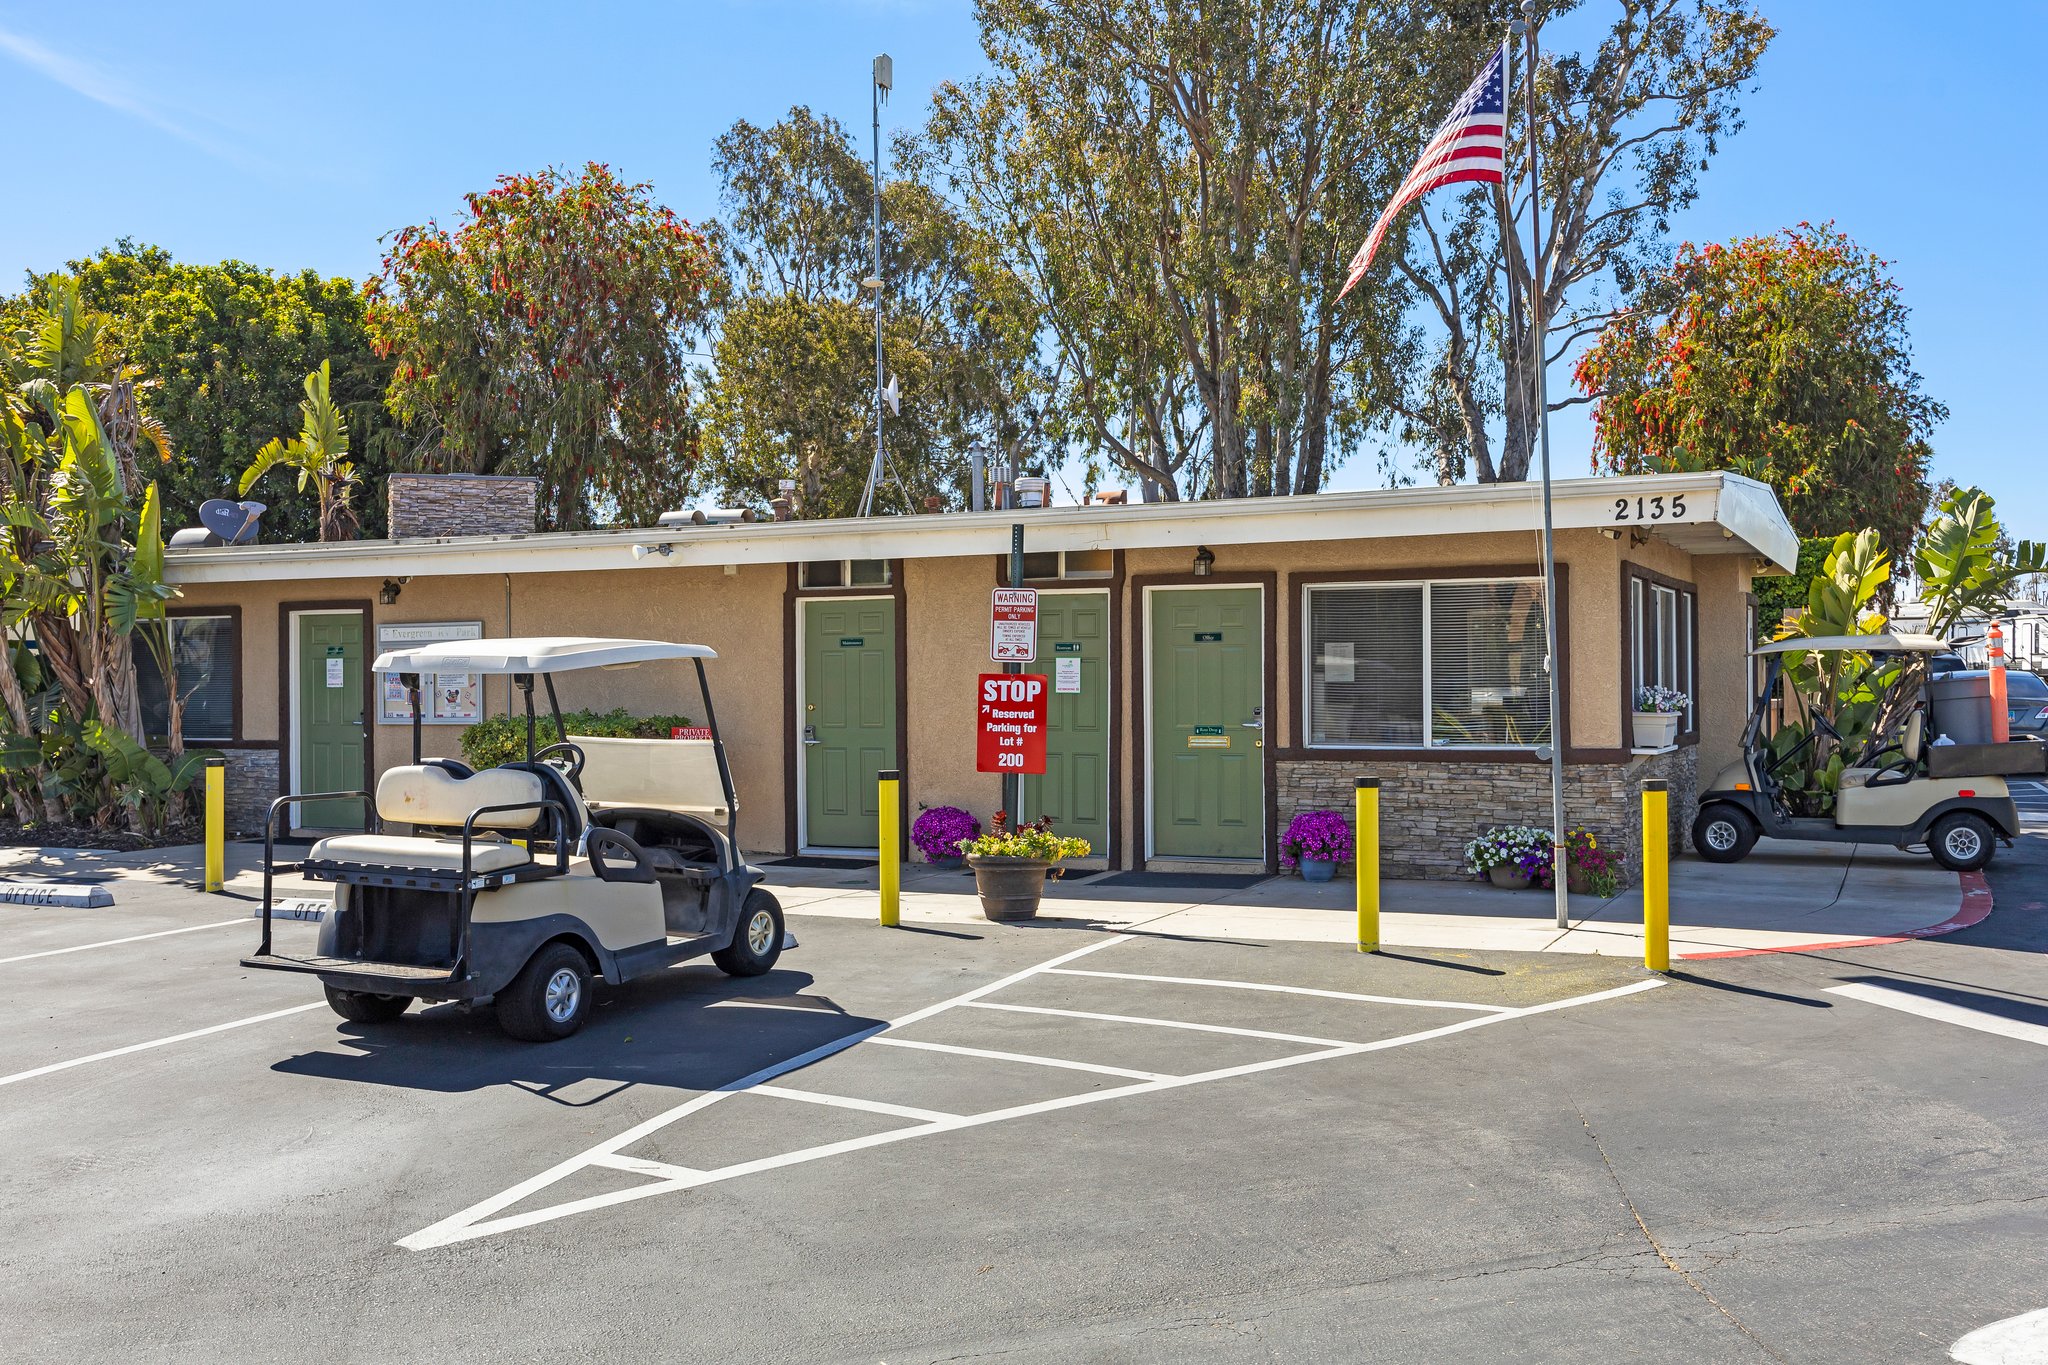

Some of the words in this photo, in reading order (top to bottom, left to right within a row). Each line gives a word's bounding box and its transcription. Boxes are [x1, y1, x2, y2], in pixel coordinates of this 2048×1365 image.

[1615, 494, 1686, 520] 2135
[997, 593, 1033, 603] WARNING
[392, 629, 432, 639] Evergreen
[983, 680, 1041, 702] STOP
[992, 709, 1035, 719] Reserved
[986, 722, 1021, 735] Parking
[1023, 724, 1037, 733] for
[1000, 737, 1014, 746] Lot
[1016, 737, 1023, 746] #
[998, 753, 1023, 767] 200
[6, 887, 57, 904] OFFICE
